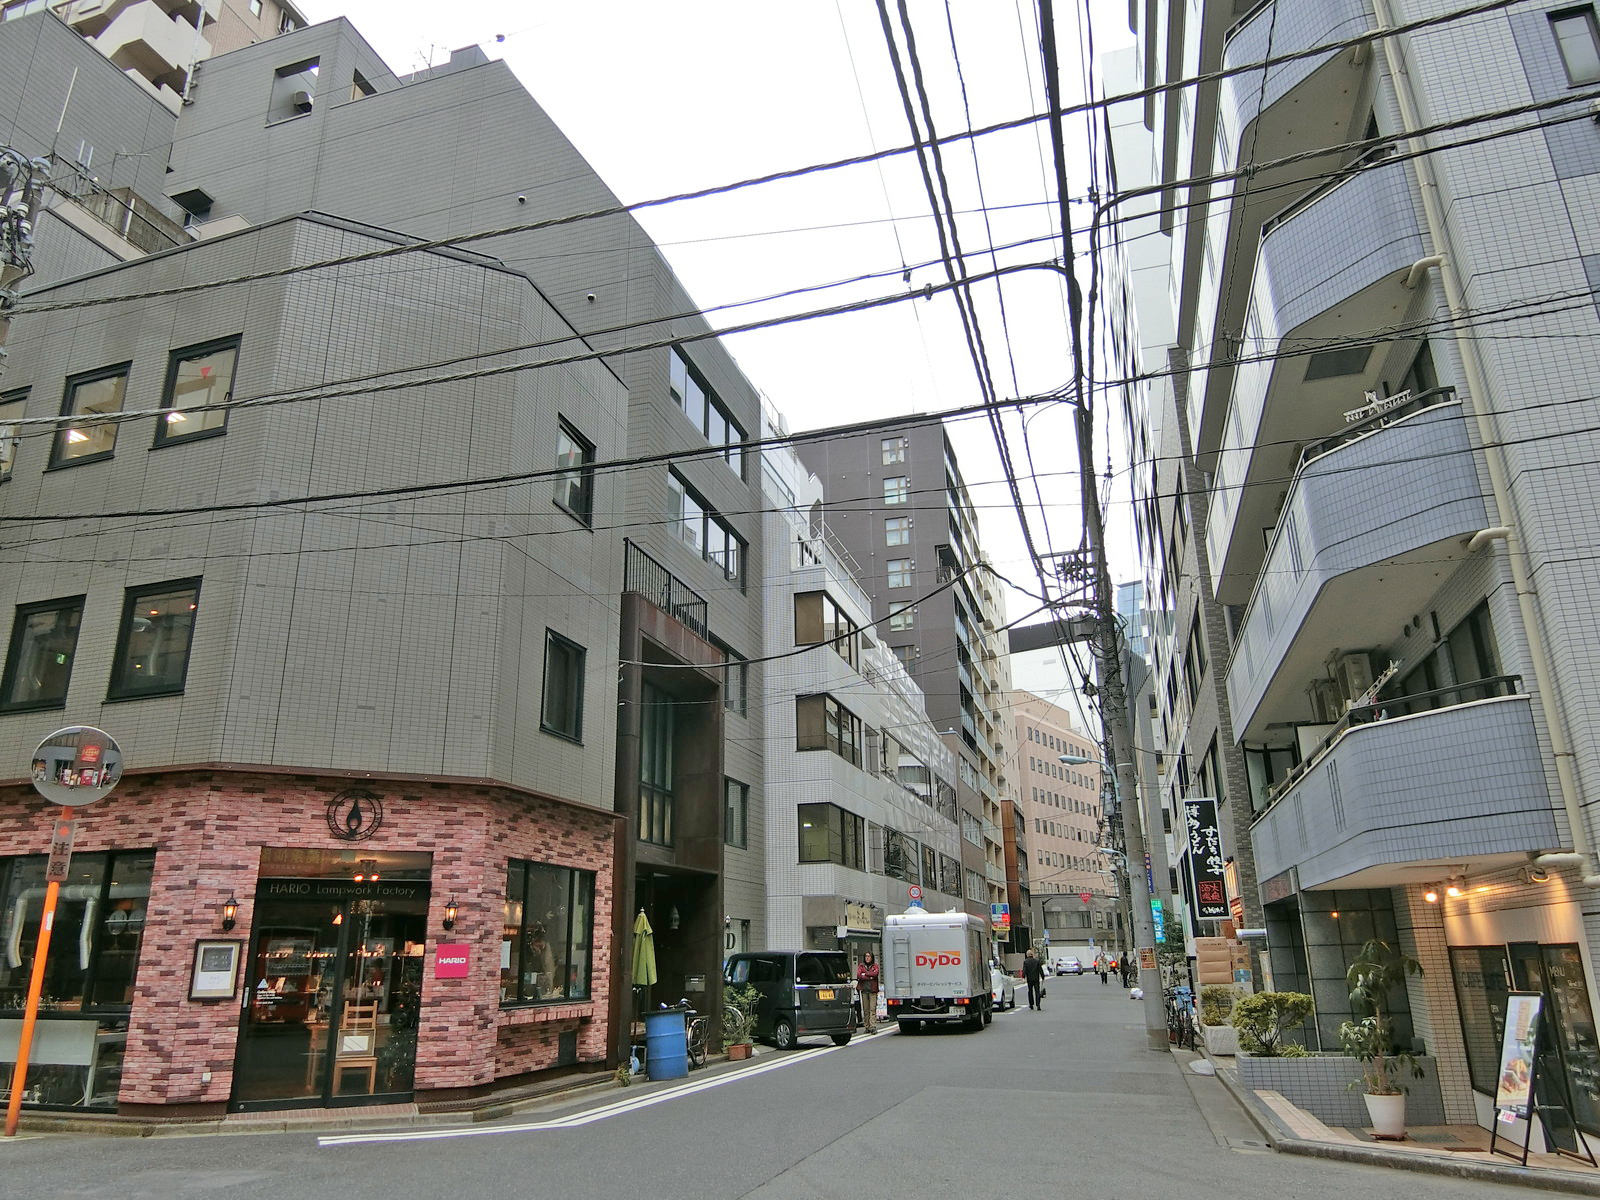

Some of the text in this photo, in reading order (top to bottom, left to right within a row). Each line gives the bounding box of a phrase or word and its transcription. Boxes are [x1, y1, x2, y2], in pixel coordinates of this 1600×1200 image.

[1185, 804, 1205, 855] 博多うどん
[49, 841, 70, 877] 注意
[270, 883, 416, 898] HARIO Lampwork Factory
[915, 954, 961, 969] DyDo
[1549, 966, 1566, 977] MENU
